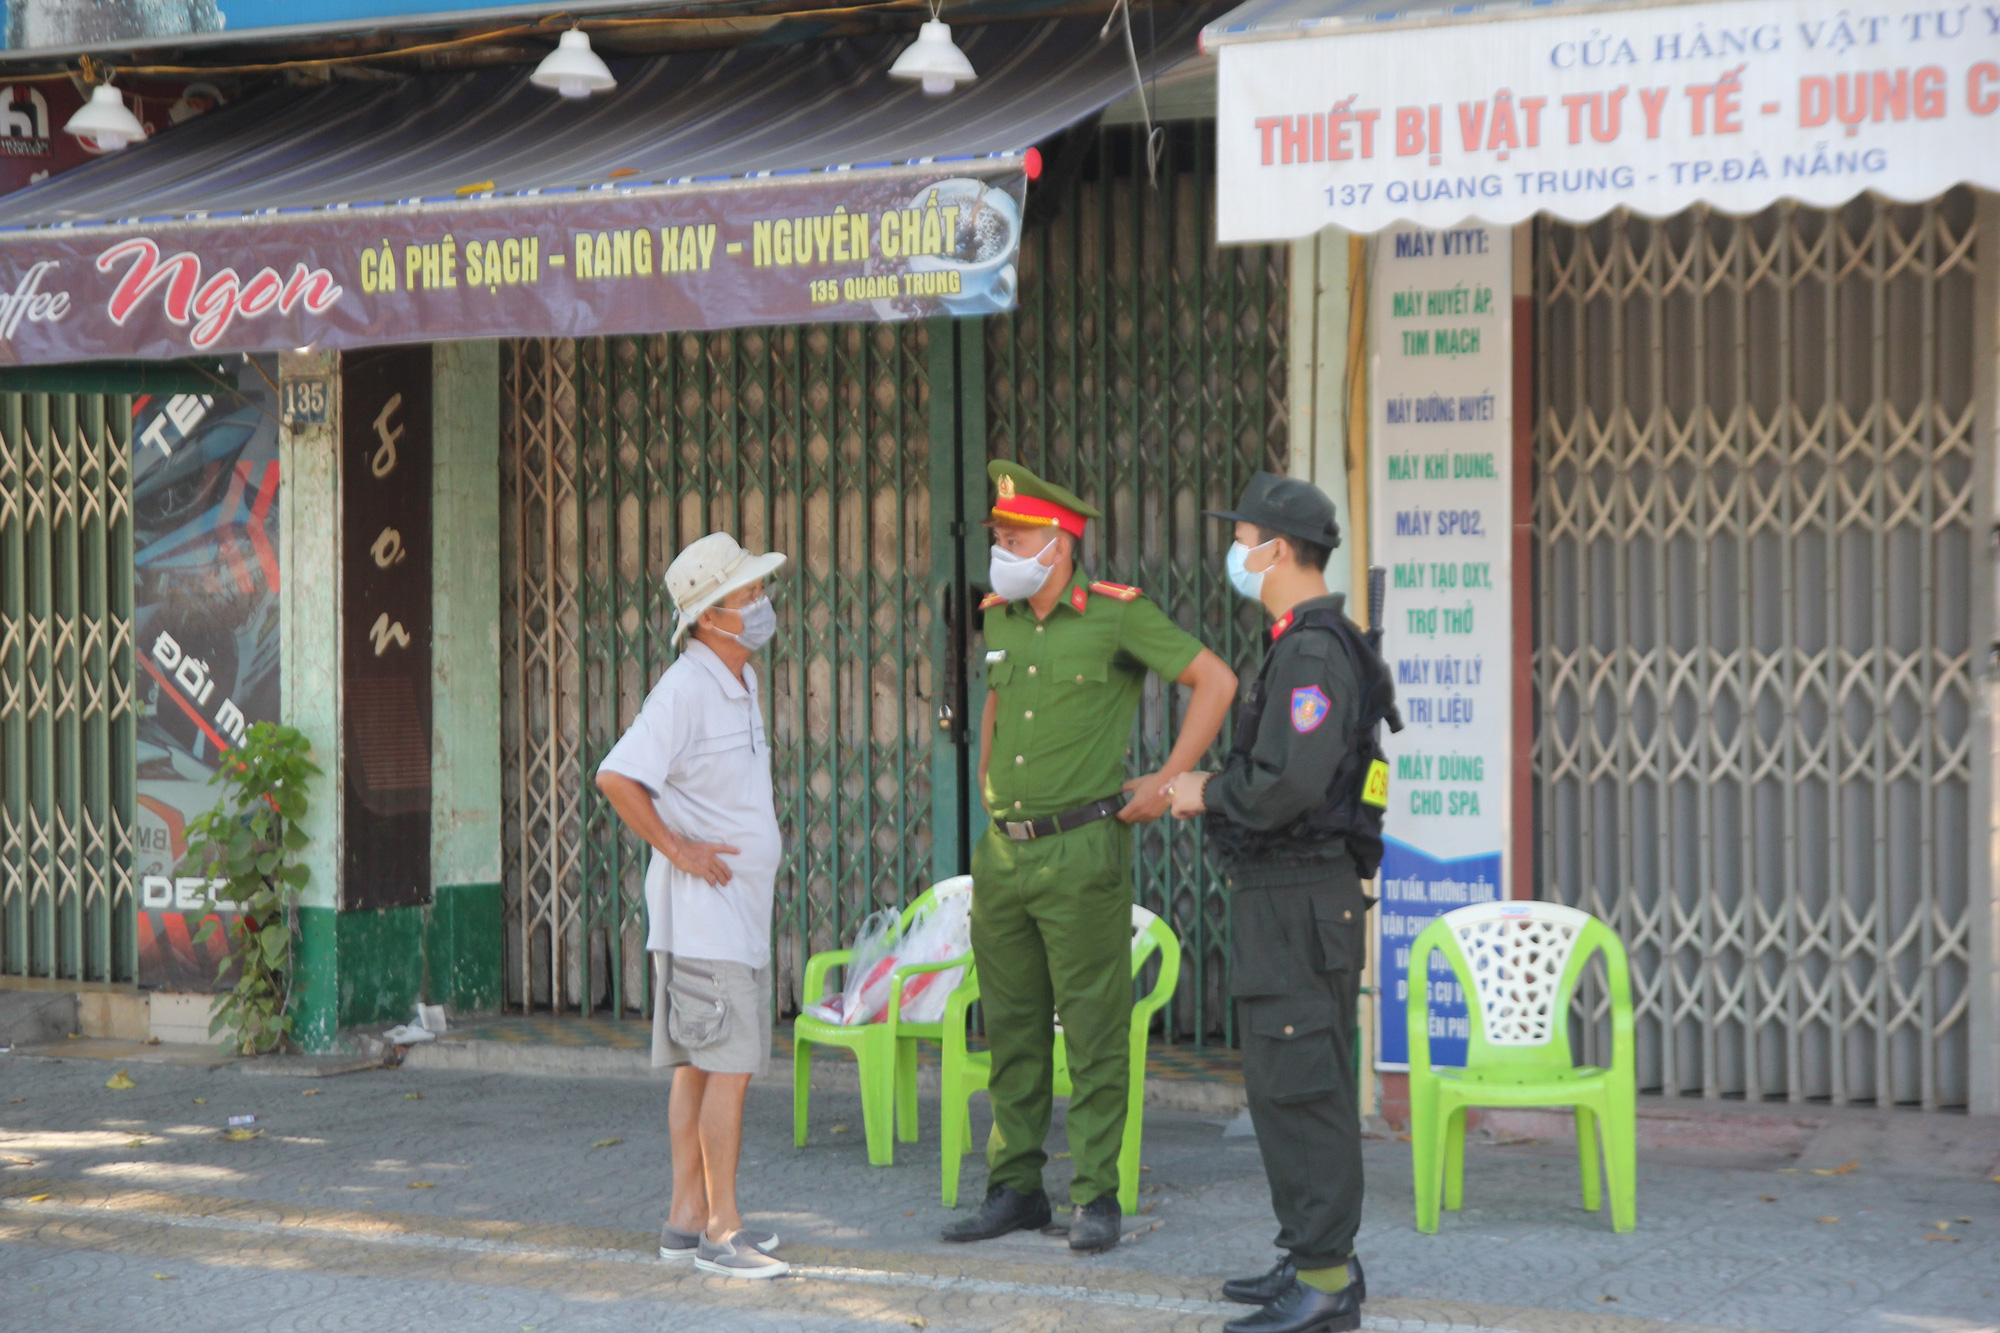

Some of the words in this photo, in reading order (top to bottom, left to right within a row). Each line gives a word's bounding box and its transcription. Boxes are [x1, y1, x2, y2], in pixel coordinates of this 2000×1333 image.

[1550, 28, 1638, 69] CỬA
[1653, 21, 1782, 62] HÀNG
[1799, 9, 1889, 56] VẬT
[1902, 2, 1971, 42] TƯ
[1255, 93, 1381, 166] THIẾT
[1396, 103, 1442, 166] BỊ
[1458, 87, 1548, 162] VẬT
[1561, 83, 1628, 145] TƯ
[1639, 86, 1668, 138] Y
[1685, 62, 1747, 137] TẾ
[1799, 65, 1946, 138] DỤNG
[1324, 183, 1375, 207] 137
[1386, 174, 1503, 204] QUANG
[1516, 165, 1635, 195] TRUNG
[1783, 140, 1887, 176] NẴNG
[360, 238, 396, 293] CÀ
[406, 233, 457, 290] PHÊ
[465, 236, 539, 295] SẠCH
[575, 228, 652, 279] RANG
[661, 224, 716, 272] XAY
[753, 204, 869, 267] NGUYÊN
[881, 189, 960, 258] CHẤT
[1395, 226, 1436, 258] MÁY
[96, 237, 343, 349] Ngon
[809, 279, 839, 301] 135
[844, 275, 898, 300] QUANG
[904, 271, 961, 296] TRUNG
[1393, 285, 1423, 317] MÁY
[1427, 280, 1470, 315] HUYẾT
[1402, 329, 1429, 356] TIM
[1435, 327, 1480, 360] MẠCH
[286, 382, 325, 414] 135
[1387, 392, 1412, 423] MÁY
[1459, 386, 1495, 421] HUYẾT
[140, 393, 215, 458] TE
[1388, 449, 1420, 480] MÁY
[1424, 448, 1449, 479] KHÍ
[1396, 504, 1431, 536] MÁY
[1394, 557, 1424, 588] MÁY
[1429, 562, 1458, 594] TẠO
[1407, 605, 1438, 639] TRỢ
[1443, 599, 1473, 634] THỞ
[152, 630, 215, 706] ĐỔI
[1399, 653, 1430, 684] MÁY
[1435, 653, 1461, 690] VẬT
[1466, 653, 1482, 684] LÝ
[1408, 697, 1433, 728] TRỊ
[1438, 692, 1473, 728] LIỆU
[1371, 768, 1388, 797] CS
[1398, 749, 1433, 780] MÁY
[1439, 749, 1484, 781] DÙNG
[1410, 789, 1442, 815] CHO
[1448, 790, 1480, 816] SPA
